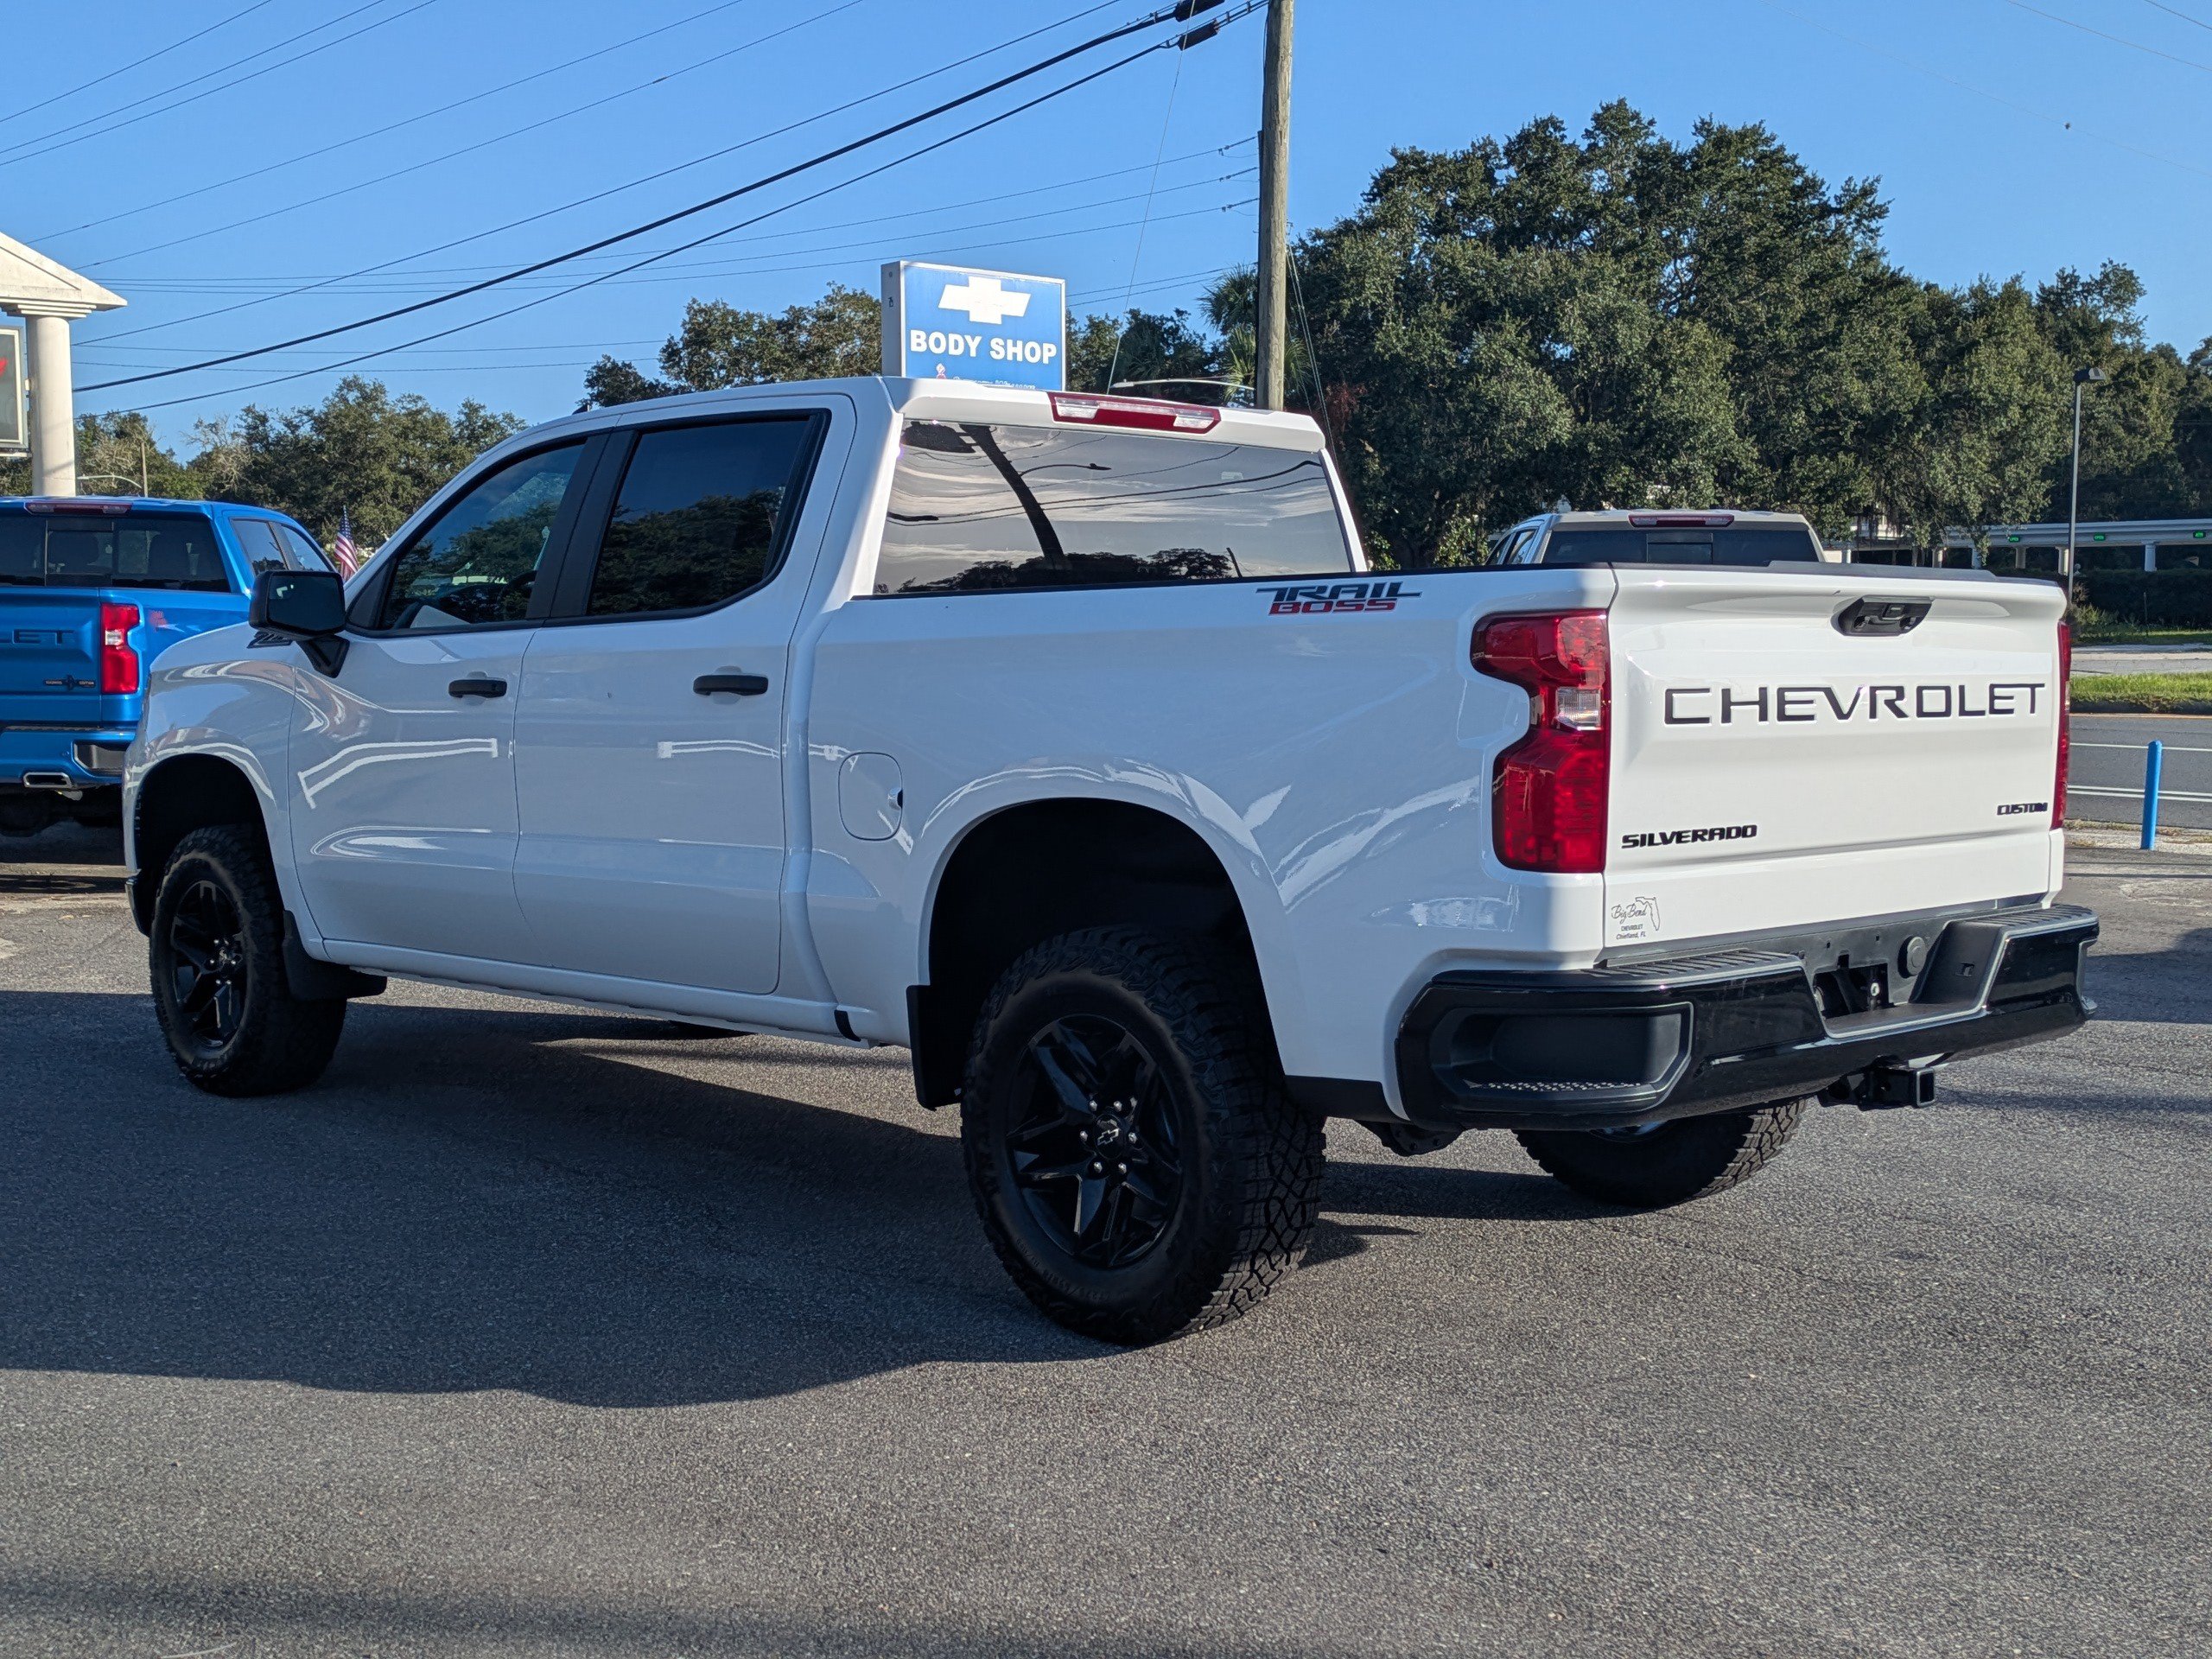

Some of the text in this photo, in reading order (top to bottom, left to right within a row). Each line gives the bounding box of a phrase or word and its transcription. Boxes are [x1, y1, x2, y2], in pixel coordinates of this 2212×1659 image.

[910, 329, 1057, 365] BODY SHOP
[1255, 582, 1422, 602] TRAIL
[1268, 597, 1398, 616] BOSS
[1664, 683, 2046, 726] CHEVROLET
[1997, 802, 2049, 816] CUSTOM
[1621, 824, 1758, 849] SILVERADO
[1611, 902, 1648, 925] Big Bend
